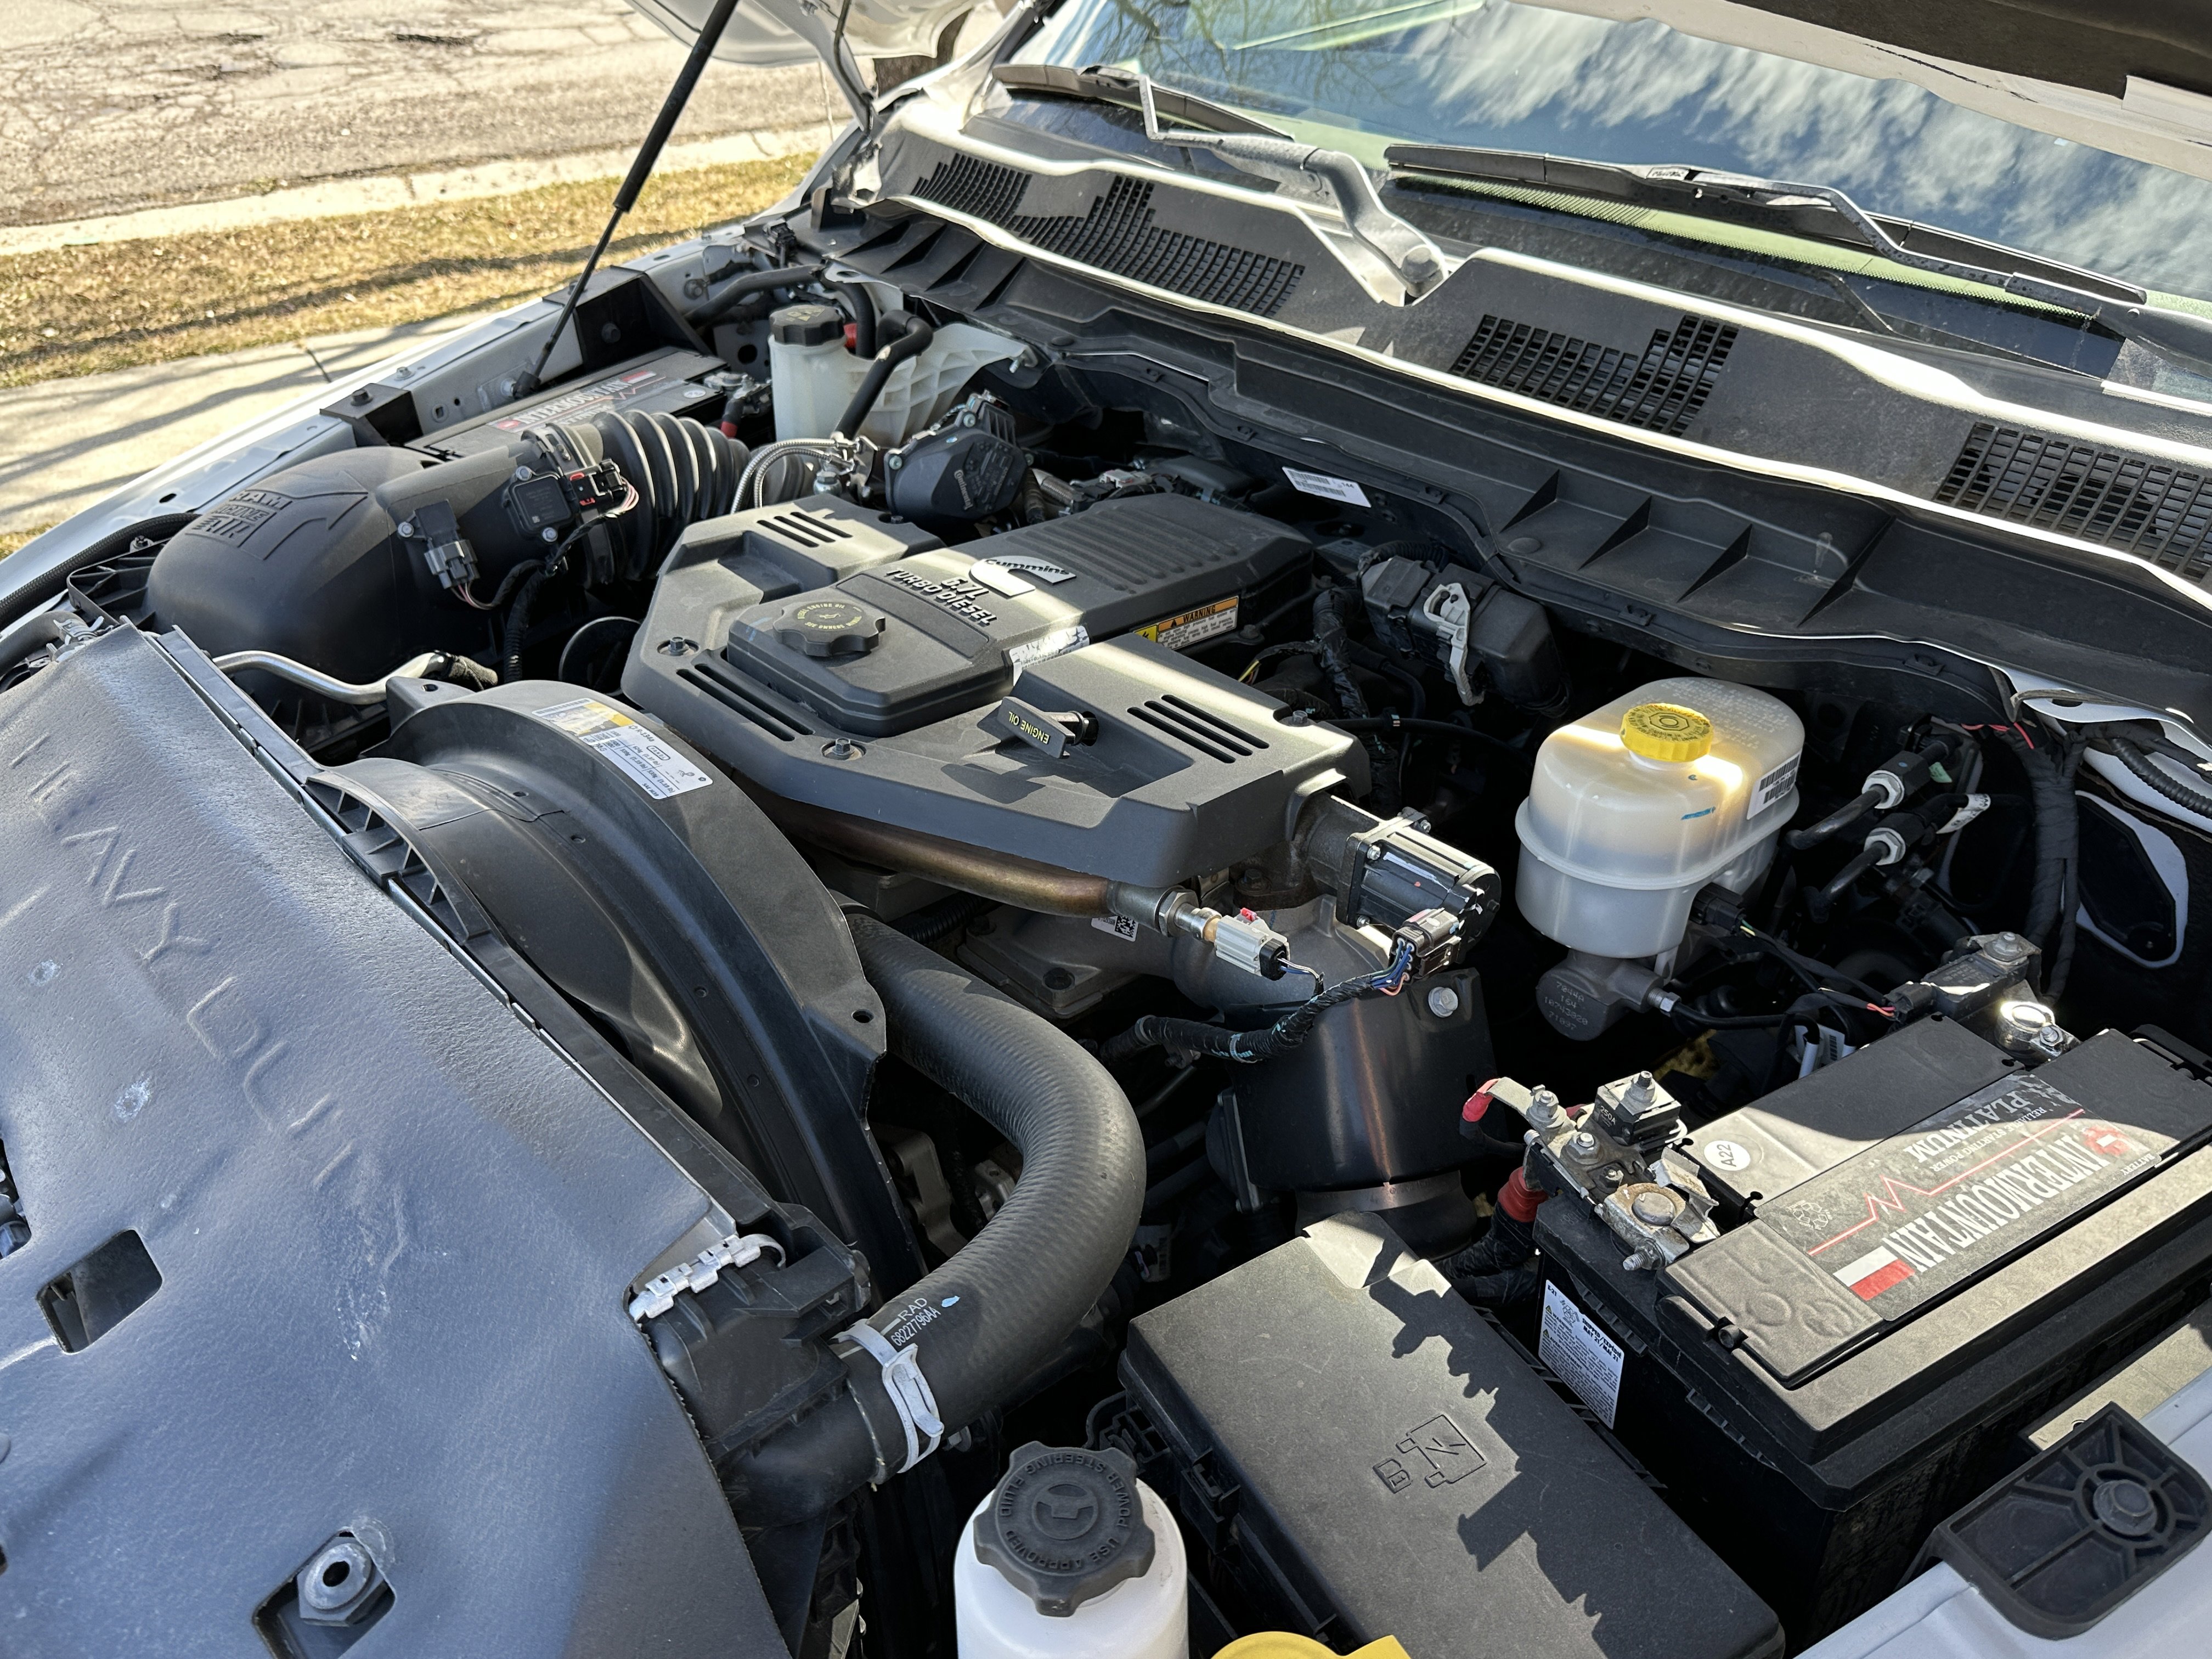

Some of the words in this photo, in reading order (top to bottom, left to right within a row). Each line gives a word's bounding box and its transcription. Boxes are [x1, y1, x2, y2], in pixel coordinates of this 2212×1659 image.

[229, 492, 293, 511] RAM
[954, 470, 974, 510] Continental
[985, 558, 1071, 575] Cummins
[885, 569, 943, 595] TURBO
[936, 590, 997, 626] DIESEL
[941, 576, 989, 599] 6.7L
[1183, 604, 1216, 623] WARNING
[1008, 711, 1020, 726] OIL
[1020, 719, 1051, 744] ENGINE
[1599, 1106, 1617, 1125] 250A
[1904, 1090, 2032, 1164] PLATINUM
[2004, 1106, 2047, 1132] RELIABLE
[1961, 1130, 2007, 1155] STARTING
[1716, 1144, 1737, 1167] A22
[1929, 1151, 1965, 1172] POWER
[2119, 1153, 2155, 1176] BATTERY
[1882, 1133, 2111, 1273] INTERMOUNTAIN
[898, 1298, 928, 1321] RAD
[890, 1306, 942, 1346] 68227796AA
[1024, 1453, 1107, 1475] STEERING
[1000, 1477, 1025, 1517] FLUID
[1106, 1472, 1130, 1528] POWER
[1006, 1530, 1083, 1570] APPROVED
[1089, 1537, 1120, 1563] USE
